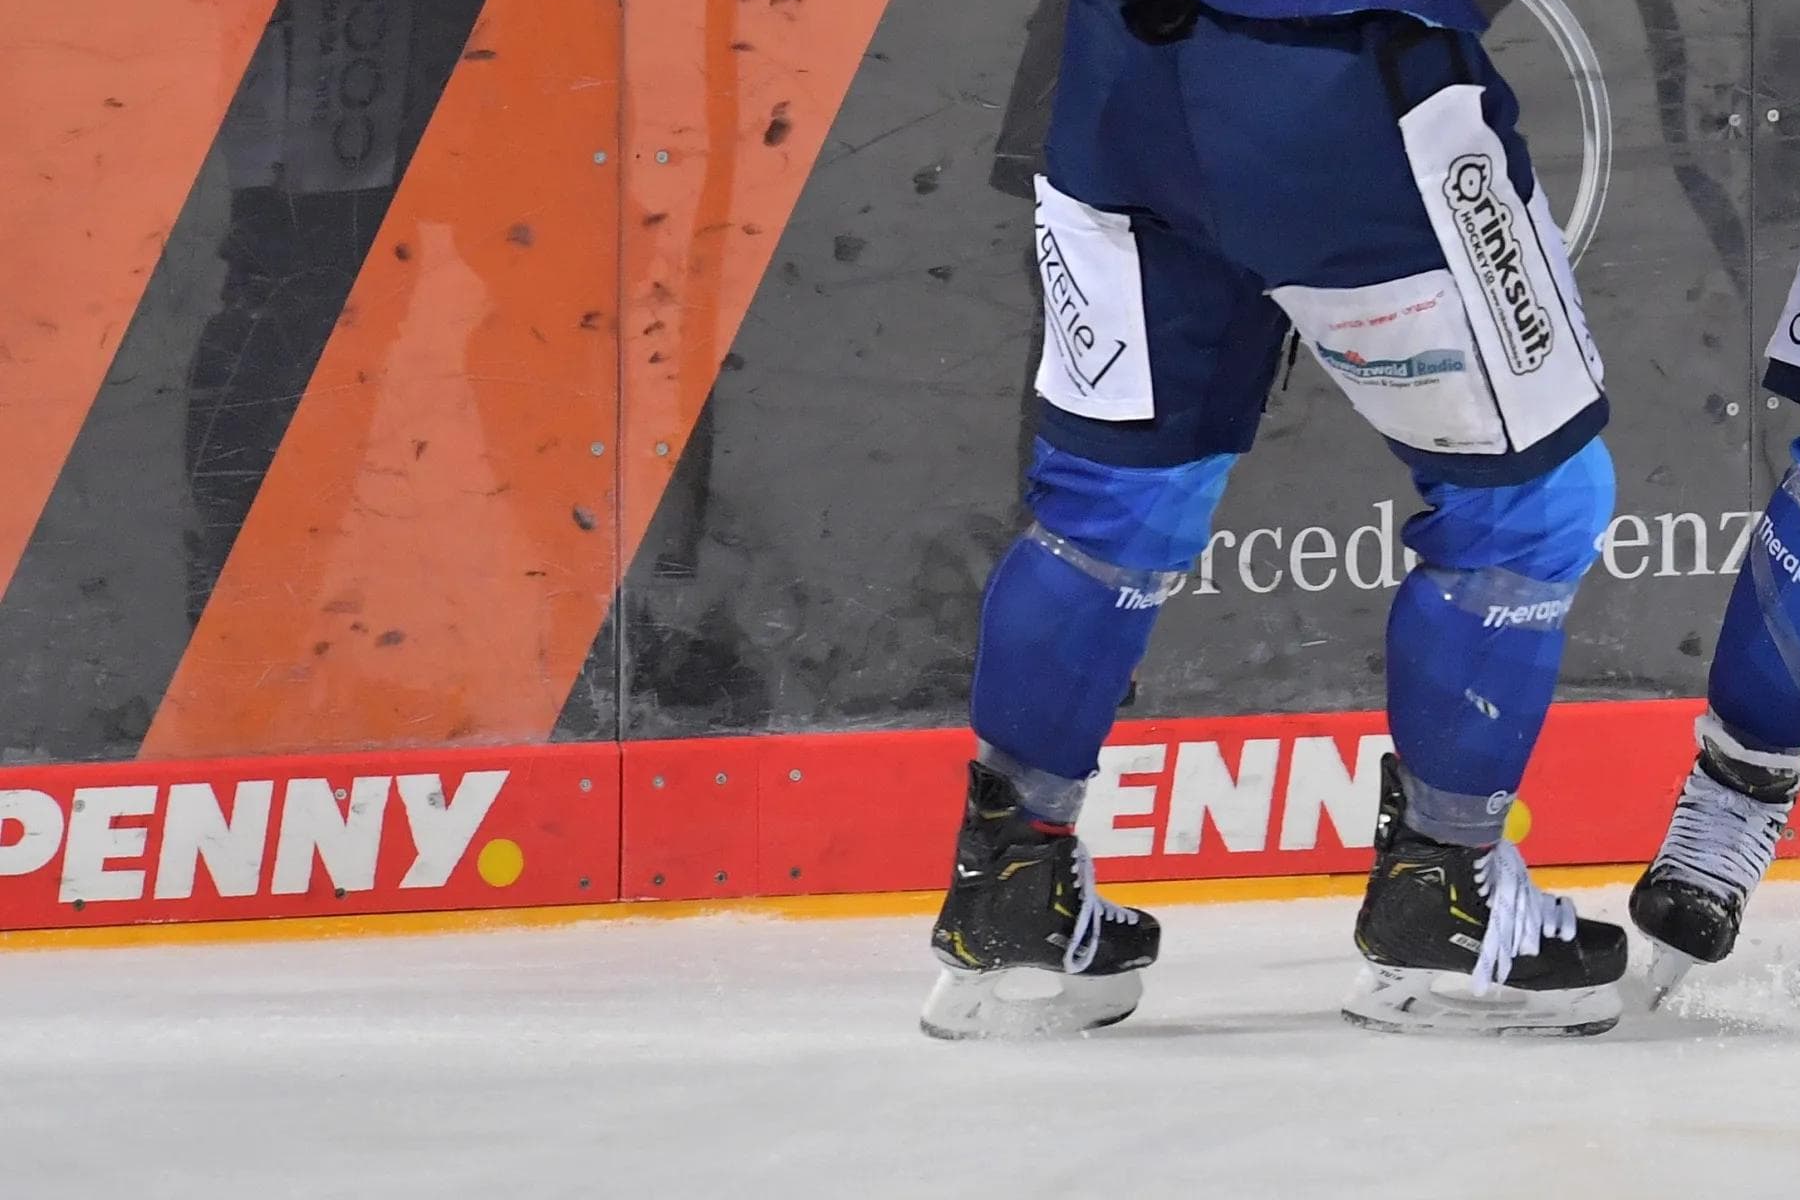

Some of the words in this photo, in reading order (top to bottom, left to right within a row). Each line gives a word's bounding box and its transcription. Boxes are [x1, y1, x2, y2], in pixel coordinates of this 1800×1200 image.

[1460, 211, 1489, 274] HOCKEY
[1166, 502, 1412, 596] rced
[1594, 510, 1766, 579] enz
[1075, 736, 1395, 860] ENN
